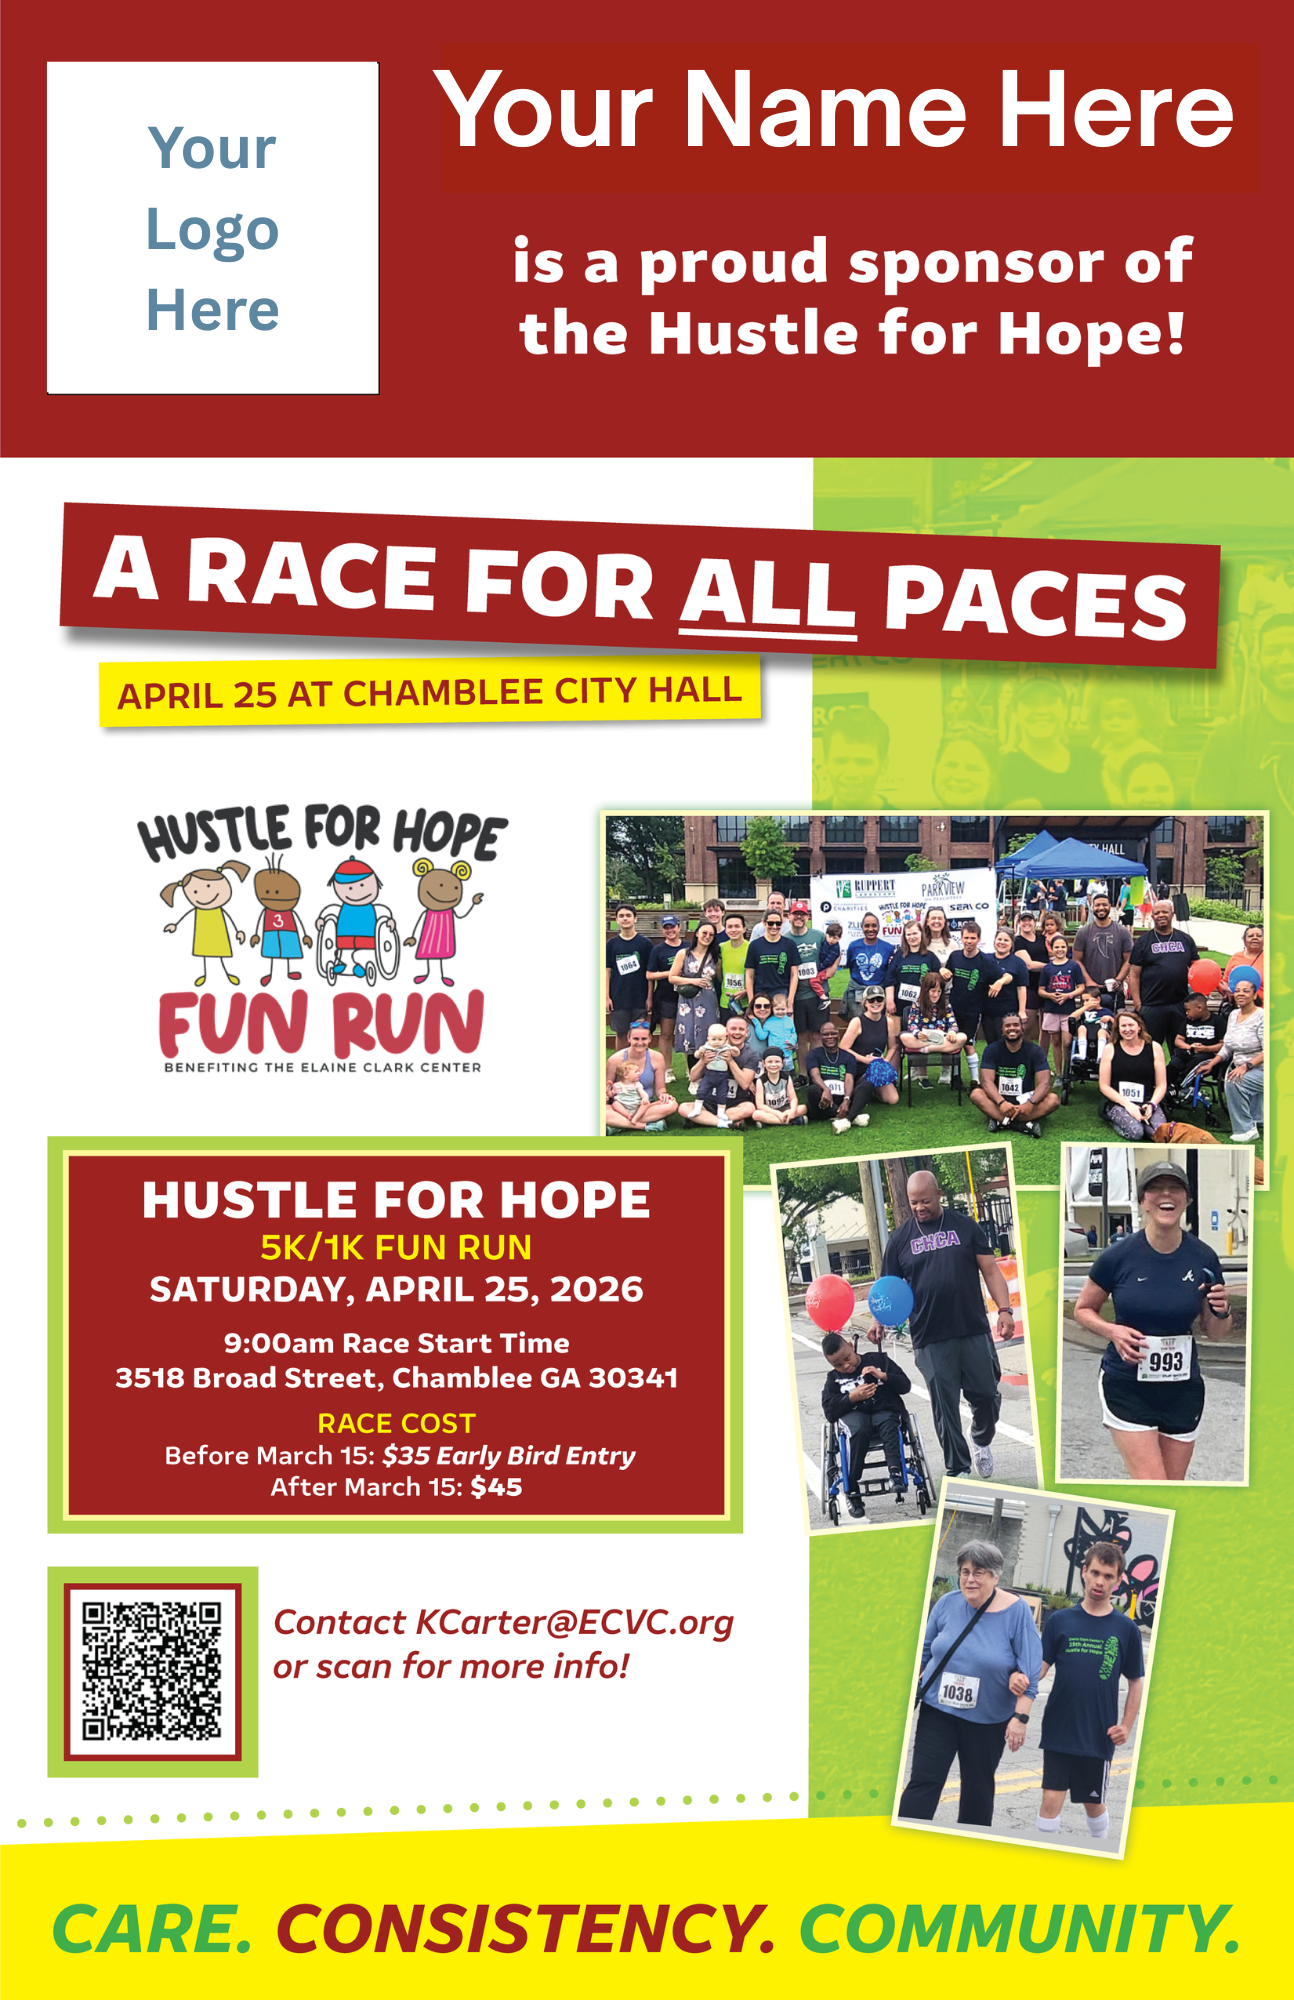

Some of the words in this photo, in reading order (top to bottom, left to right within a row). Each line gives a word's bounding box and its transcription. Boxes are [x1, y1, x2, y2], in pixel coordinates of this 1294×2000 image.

[433, 70, 653, 147] Your
[688, 70, 966, 147] Name
[1003, 70, 1233, 147] Here
[148, 127, 276, 169] Your
[149, 208, 278, 262] Logo
[515, 235, 563, 283] is
[585, 250, 617, 283] a
[641, 236, 827, 295] proud
[849, 250, 1104, 295] sponsor
[1125, 235, 1194, 283] of
[149, 289, 278, 331] Here
[519, 308, 627, 355] the
[651, 308, 857, 355] Hustle
[879, 307, 977, 355] for
[1001, 312, 1184, 367] Hope!
[93, 535, 159, 599] A
[189, 537, 436, 610] RACE
[467, 549, 652, 618] FOR
[679, 558, 856, 634] ALL
[886, 565, 1186, 641] PACES
[118, 683, 223, 709] APRIL
[234, 682, 276, 708] 25
[288, 681, 332, 707] AT
[344, 679, 542, 706] CHAMBLEE
[556, 677, 637, 704] CITY
[650, 676, 742, 702] HALL
[137, 804, 292, 868] HUSTLE
[305, 804, 380, 858] FOR
[394, 808, 509, 865] HOPE
[1102, 843, 1125, 855] HALL
[854, 879, 896, 892] RUPPERT
[921, 881, 965, 898] PARKVIEW
[878, 902, 899, 910] HUSTLE
[911, 902, 927, 910] HOPE
[271, 914, 284, 928] 3
[882, 926, 902, 935] FUN
[1151, 941, 1186, 953] CHCA
[901, 988, 918, 998] 1062
[159, 989, 308, 1059] FUN
[333, 989, 484, 1060] RUN
[165, 1063, 257, 1072] BENEFITING
[265, 1063, 293, 1072] THE
[302, 1063, 356, 1072] ELAINE
[364, 1063, 413, 1072] CLARK
[421, 1063, 480, 1072] CENTER
[1001, 1083, 1019, 1092] 1042
[1122, 1088, 1141, 1098] 1051
[144, 1181, 356, 1218] HUSTLE
[376, 1181, 484, 1218] FOR
[502, 1181, 649, 1218] HOPE
[261, 1231, 364, 1261] 5K/1K
[377, 1235, 445, 1260] FUN
[460, 1234, 530, 1260] RUN
[911, 1230, 961, 1255] CHCA
[150, 1276, 354, 1306] SATURDAY,
[366, 1276, 474, 1301] APRIL
[485, 1276, 539, 1307] 25,
[551, 1276, 643, 1302] 2026
[225, 1333, 333, 1353] 9:00am
[344, 1333, 409, 1353] Race
[418, 1333, 492, 1353] Start
[500, 1331, 569, 1353] Time
[1149, 1351, 1184, 1372] 993
[116, 1368, 184, 1388] 3518
[194, 1366, 276, 1388] Broad
[285, 1368, 384, 1391] Street,
[393, 1366, 532, 1388] Chamblee
[541, 1368, 581, 1388] GA
[589, 1368, 676, 1388] 30341
[319, 1413, 391, 1433] RACE
[402, 1413, 476, 1433] COST
[166, 1445, 248, 1465] Before
[258, 1445, 332, 1465] March
[341, 1447, 374, 1465] 15:
[382, 1443, 430, 1468] $35
[437, 1445, 501, 1470] Early
[508, 1445, 561, 1465] Bird
[566, 1447, 636, 1470] Entry
[271, 1476, 337, 1496] After
[346, 1476, 420, 1496] March
[429, 1478, 462, 1496] 15:
[471, 1475, 522, 1499] $45
[275, 1609, 406, 1634] Contact
[416, 1609, 734, 1642] KCarter@ECVC.org
[1082, 1641, 1103, 1649] Annual
[274, 1660, 309, 1678] or
[316, 1660, 391, 1678] scan
[403, 1651, 452, 1678] for
[460, 1660, 544, 1678] more
[554, 1651, 630, 1678] info!
[943, 1684, 973, 1703] 1038
[53, 1904, 250, 1953] CARE.
[278, 1904, 773, 1953] CONSISTENCY.
[801, 1904, 1238, 1953] COMMUNITY.
